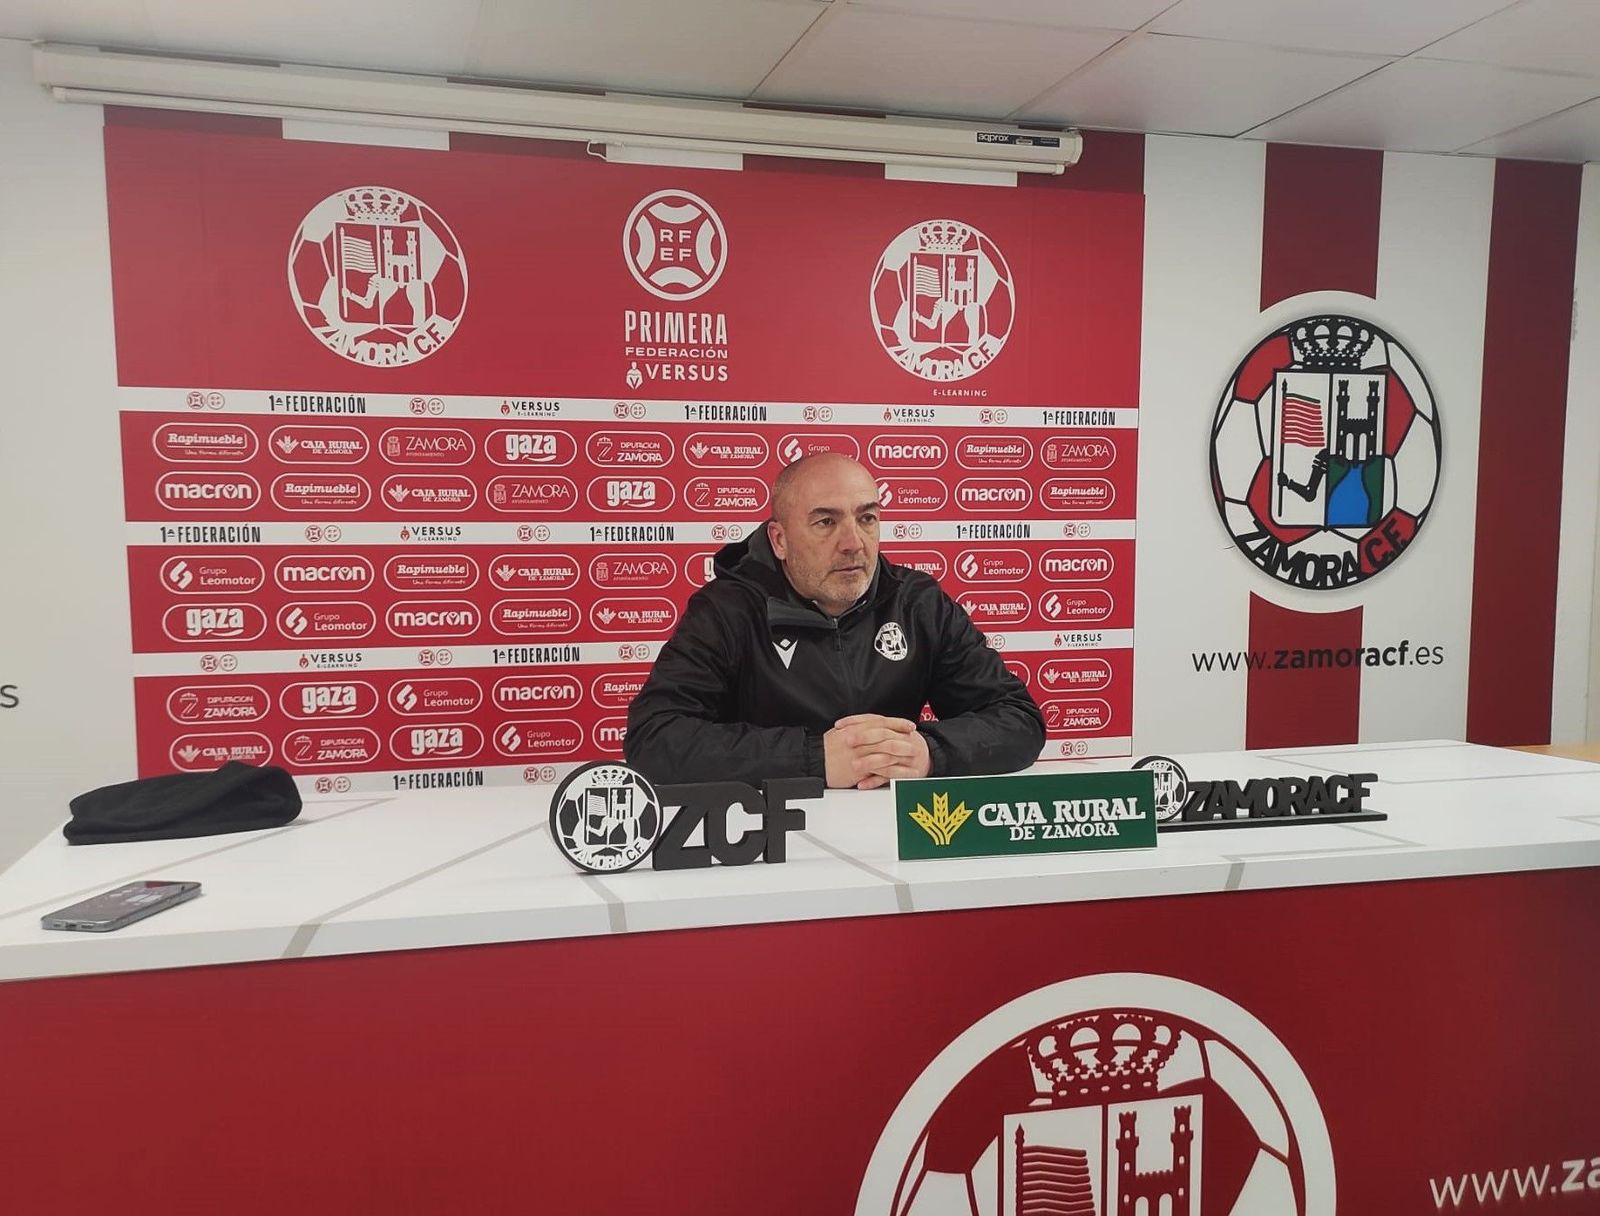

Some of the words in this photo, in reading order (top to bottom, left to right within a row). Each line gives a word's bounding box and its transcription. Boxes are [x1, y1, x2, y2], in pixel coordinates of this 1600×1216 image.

[624, 310, 728, 345] PRIMERA
[314, 326, 410, 367] ZAMORA
[413, 323, 446, 355] C.F.
[625, 346, 728, 358] FEDERACIÓN
[887, 346, 965, 380] ZAMORA
[968, 340, 995, 371] C.F.
[645, 363, 728, 381] VERSUS
[933, 389, 987, 397] E-LEARNING
[285, 395, 366, 414] FEDERACIÓN
[511, 401, 560, 412] VERSUS
[699, 403, 767, 422] FEDERACIÓN
[893, 408, 935, 418] VERSUS
[1055, 409, 1116, 426] FEDERACIÓN
[167, 433, 244, 446] Rapimueble
[300, 440, 327, 450] CAJA
[328, 441, 363, 450] RURAL
[405, 436, 467, 450] ZAMORA
[505, 434, 557, 460] gaza
[710, 446, 732, 454] CAJA
[733, 447, 764, 455] RURAL
[808, 443, 830, 452] Grupo
[875, 444, 941, 459] macron
[966, 444, 1022, 454] Rapimueble
[1061, 443, 1109, 457] ZAMORA
[617, 452, 664, 462] ZAMORA
[165, 483, 252, 499] macron
[285, 483, 357, 496] Rapimueble
[411, 488, 435, 497] CAJA
[437, 488, 471, 497] RURAL
[511, 483, 570, 498] ZAMORA
[606, 481, 656, 506] gaza
[897, 487, 919, 496] Grupo
[961, 487, 1026, 501] macron
[1050, 486, 1104, 497] Rapimueble
[714, 498, 758, 507] ZAMORA
[897, 496, 941, 504] Leomotor
[177, 524, 260, 543] FEDERACIÓN
[411, 526, 461, 536] VERSUS
[604, 524, 674, 542] FEDERACIÓN
[969, 522, 1031, 539] FEDERACIÓN
[1236, 520, 1362, 588] ZAMORA
[613, 561, 669, 575] ZAMORA
[914, 562, 942, 572] RURAL
[983, 559, 1003, 568] Grupo
[1045, 557, 1108, 572] macron
[199, 566, 227, 576] Grupo
[283, 566, 366, 582] macron
[397, 564, 465, 576] Rapimueble
[518, 568, 541, 576] CAJA
[543, 568, 574, 577] RURAL
[983, 567, 1025, 575] Leomotor
[200, 575, 256, 586] Leomotor
[978, 603, 999, 611] CAJA
[1000, 602, 1027, 610] RURAL
[1066, 598, 1087, 607] Grupo
[502, 608, 568, 620] Rapimueble
[617, 610, 640, 619] CAJA
[641, 610, 672, 618] RURAL
[1066, 606, 1107, 615] Leomotor
[186, 608, 244, 636] gaza
[314, 612, 340, 622] Grupo
[394, 610, 473, 627] macron
[314, 621, 368, 631] Leomotor
[1063, 633, 1102, 642] VERSUS
[310, 652, 362, 663] VERSUS
[508, 644, 580, 663] FEDERACIÓN
[1192, 640, 1444, 672] www.zamoracf.es
[1061, 671, 1081, 679] CAJA
[1082, 670, 1107, 678] RURAL
[423, 688, 448, 698] Grupo
[500, 684, 575, 701] macron
[302, 686, 357, 714] gaza
[424, 697, 474, 707] Leomotor
[203, 706, 258, 719] ZAMORA
[1063, 716, 1102, 727] ZAMORA
[526, 730, 551, 739] Grupo
[411, 728, 463, 755] gaza
[527, 738, 576, 748] Leomotor
[230, 745, 266, 755] RURAL
[317, 748, 368, 760] ZAMORA
[409, 768, 484, 789] FEDERACIÓN
[1182, 773, 1378, 822] ZAMORACF
[978, 802, 1047, 827] CAJA
[1053, 797, 1146, 823] RURAL
[653, 777, 824, 871] ZCF
[1009, 825, 1036, 841] DE
[1042, 822, 1119, 840] ZAMORA
